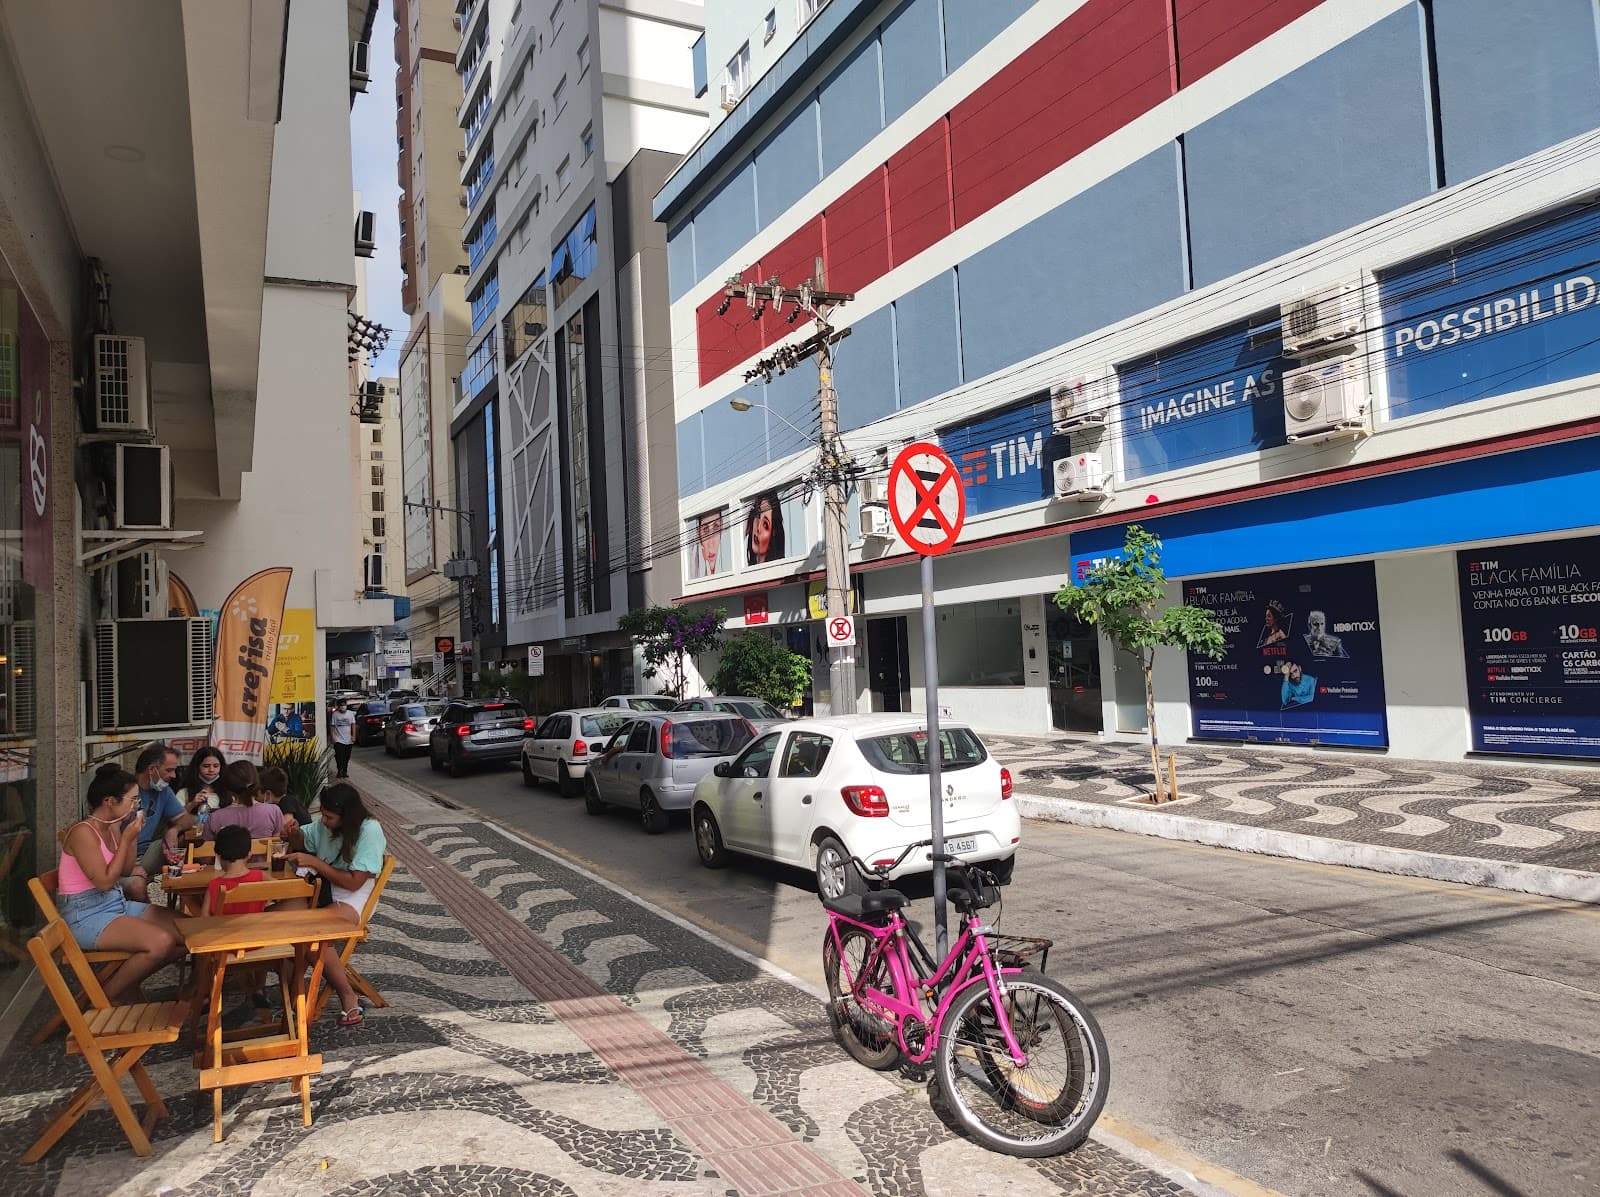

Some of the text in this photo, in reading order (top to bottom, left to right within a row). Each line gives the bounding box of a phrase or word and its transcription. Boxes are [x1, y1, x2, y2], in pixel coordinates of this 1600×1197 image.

[1140, 369, 1276, 430] IMAGINE AS
[990, 431, 1043, 480] TIM
[1480, 561, 1498, 571] TIM
[1470, 563, 1581, 586] BLACK FAMÍLIA
[1472, 590, 1503, 600] VENHA
[1505, 587, 1528, 597] PARA
[1530, 586, 1538, 596] O
[1540, 585, 1556, 595] TIM
[1558, 582, 1589, 594] BLACK
[1189, 594, 1218, 606] BLACK
[1473, 600, 1503, 610] CONTA
[1504, 598, 1519, 608] NO
[1520, 597, 1532, 607] C6
[1534, 595, 1560, 606] BANK
[1562, 595, 1568, 604] E
[1263, 647, 1287, 656] NETFLIX
[1562, 649, 1597, 659] CARTÃO
[238, 617, 268, 717] crefisa
[1563, 660, 1573, 668] C6
[1510, 696, 1563, 704] CONCIERGE
